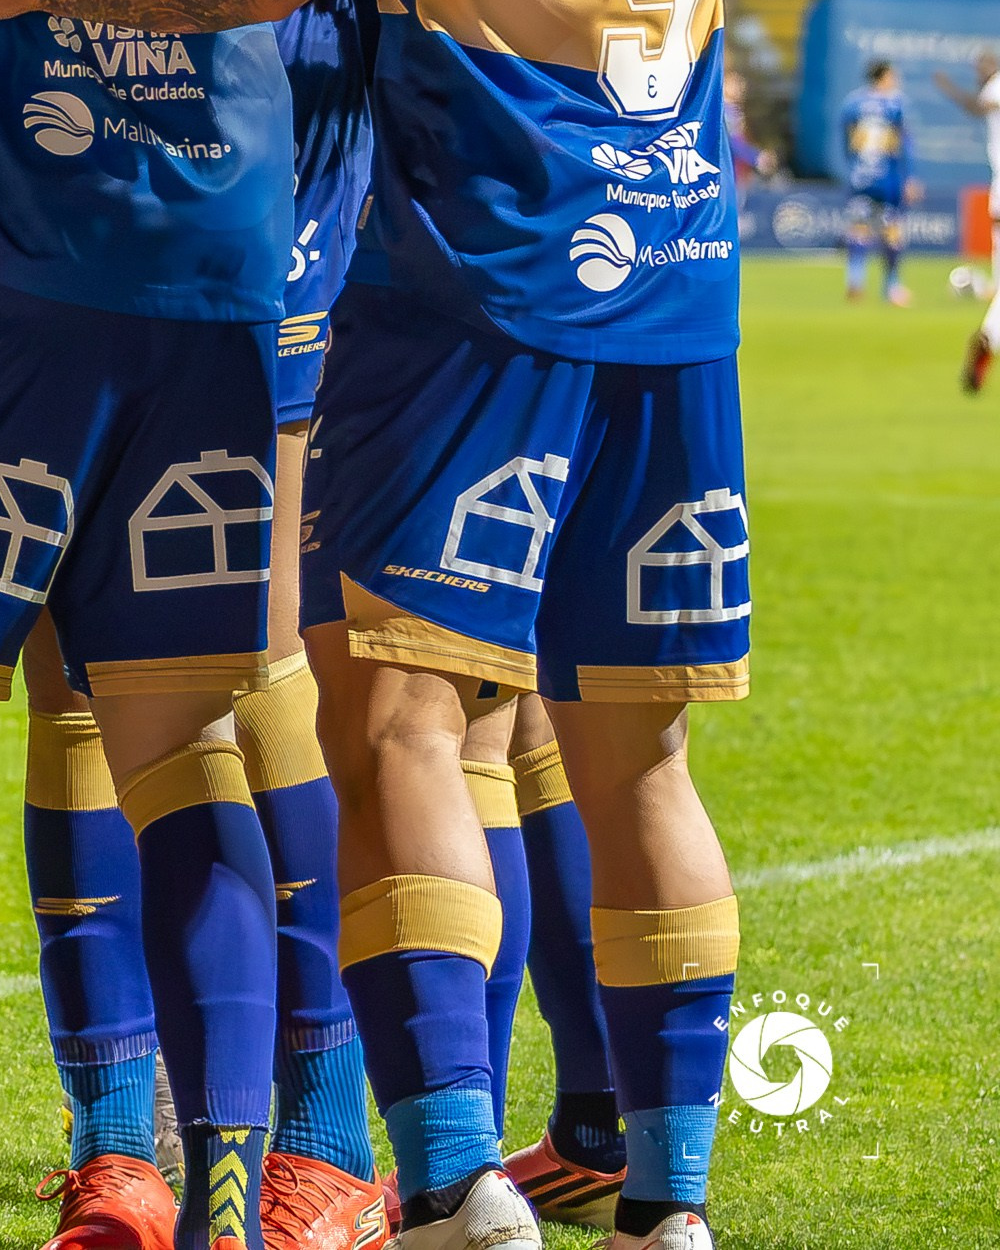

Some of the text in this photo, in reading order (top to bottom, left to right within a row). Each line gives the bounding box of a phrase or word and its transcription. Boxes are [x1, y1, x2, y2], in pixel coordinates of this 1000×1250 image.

[92, 40, 197, 77] VIÑA
[130, 81, 206, 101] Cuidados
[382, 564, 492, 593] SKECHERS
